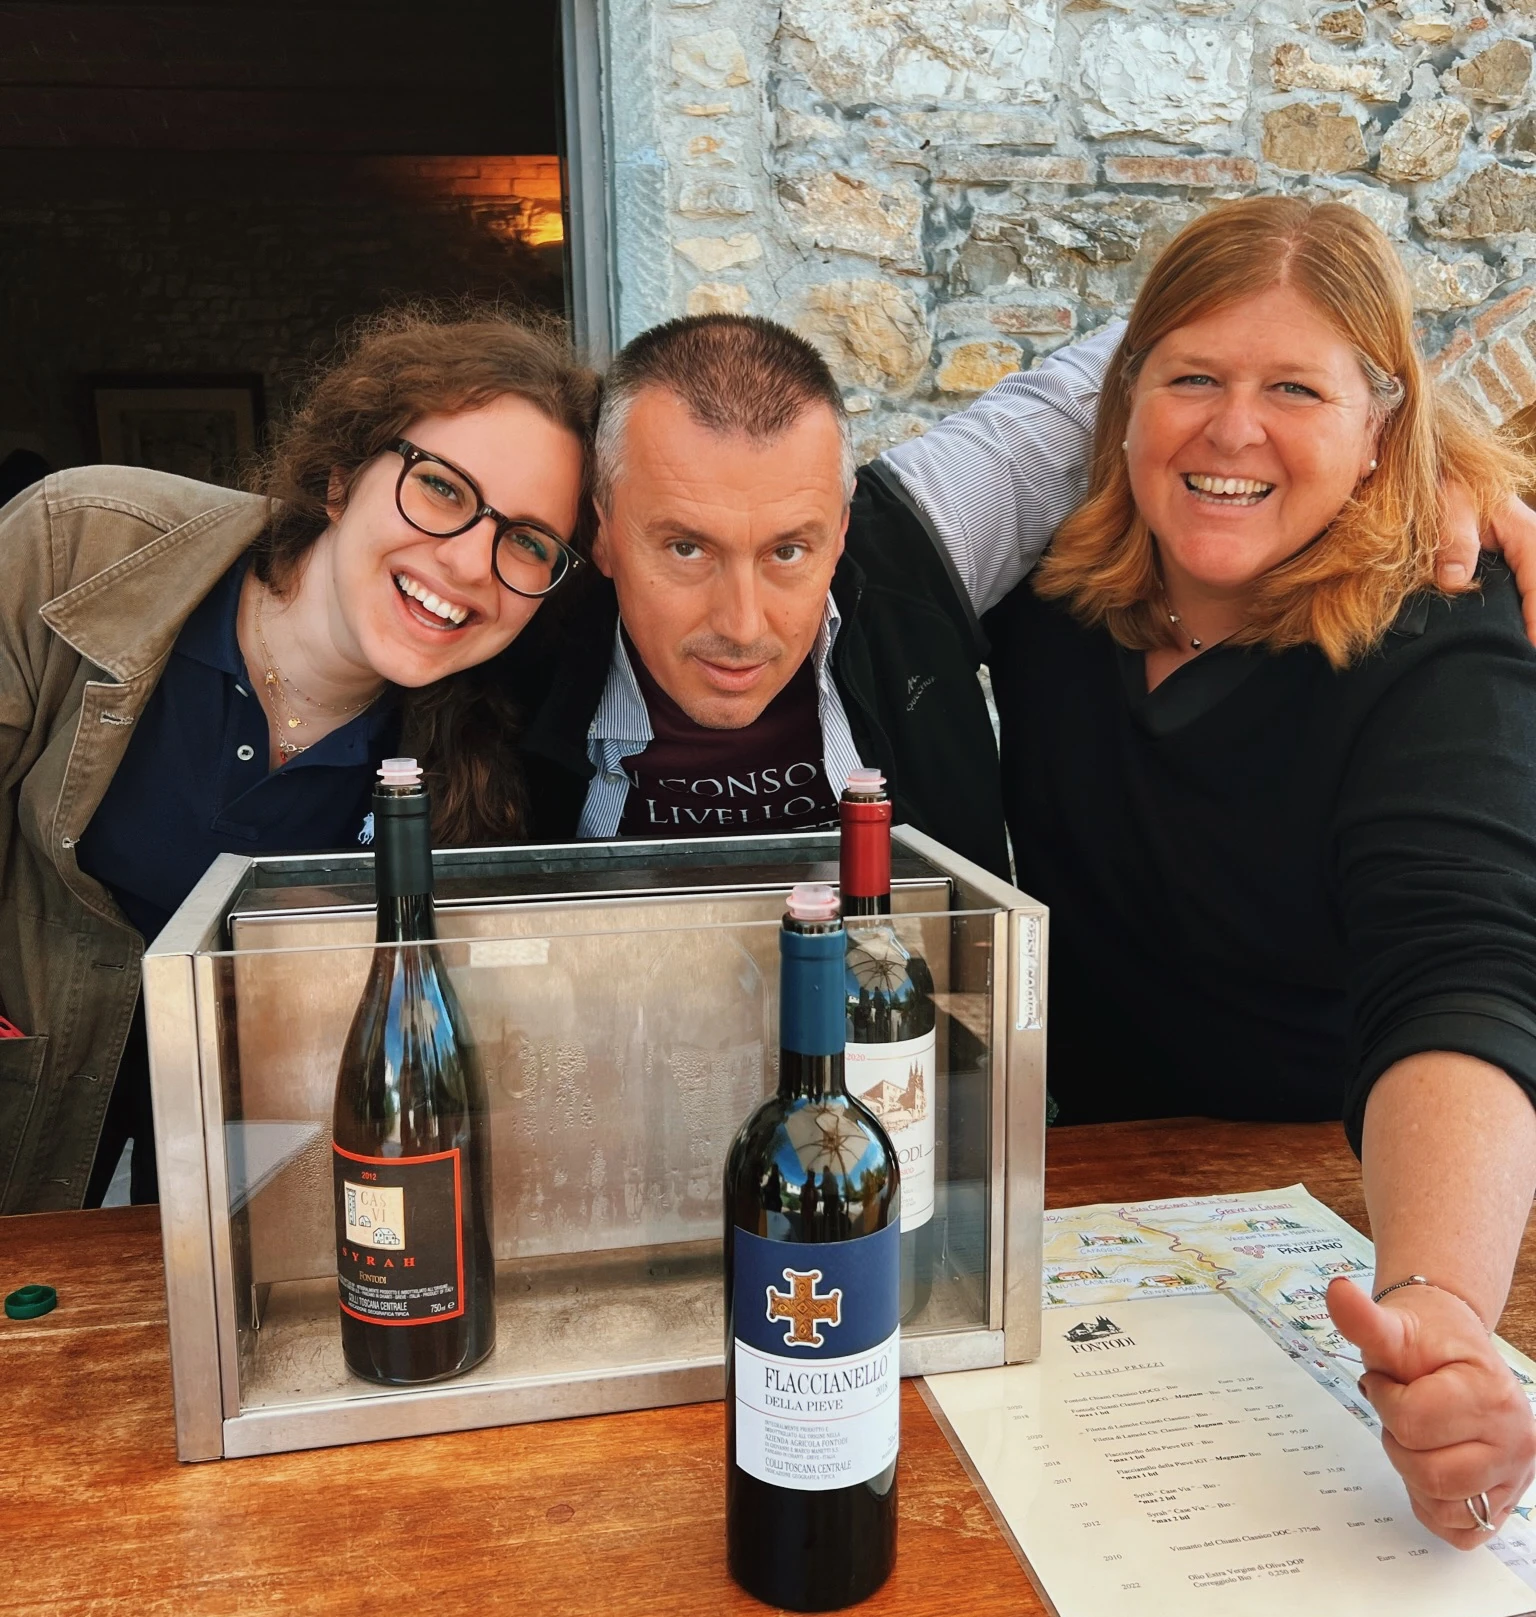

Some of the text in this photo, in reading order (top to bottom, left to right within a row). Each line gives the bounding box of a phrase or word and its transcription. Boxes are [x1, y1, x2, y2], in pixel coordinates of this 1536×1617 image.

[658, 758, 826, 798] CONSO
[845, 1053, 866, 1061] 2020
[361, 1171, 377, 1181] 2012
[1277, 1242, 1343, 1255] PANZANO
[342, 1247, 416, 1268] SYRAH
[359, 1297, 380, 1309] TOSCANA
[380, 1302, 408, 1311] CENTRALE
[1071, 1337, 1137, 1353] FONTODI
[764, 1354, 888, 1395] FLACCIANELLO
[1073, 1361, 1165, 1378] LISTINO PREZZI
[764, 1394, 843, 1411] DELLA PIEVE
[1064, 1395, 1088, 1404] Fontodi
[1088, 1393, 1110, 1401] Chianti
[1112, 1390, 1138, 1399] Classico
[1138, 1387, 1160, 1396] DOCG
[1071, 1405, 1095, 1413] Fontodi
[1096, 1403, 1118, 1411] Chianti
[1119, 1400, 1146, 1409] Classico
[1146, 1396, 1169, 1405] DOCG
[1175, 1392, 1203, 1400] Magnum
[1163, 1415, 1190, 1423] Classico
[1160, 1426, 1187, 1434] Classico
[1194, 1422, 1223, 1430] Magnum
[765, 1433, 848, 1448] AZIENDA AGRICOLA FONTODI
[1104, 1448, 1144, 1458] Flaccianello
[1162, 1443, 1181, 1451] Pieve
[765, 1457, 852, 1474] COLLI TOSCANA CENTRALE
[1116, 1465, 1156, 1475] Flaccianello
[1157, 1462, 1174, 1470] della
[1175, 1459, 1194, 1467] Pieve
[1133, 1491, 1153, 1499] Syrah
[1147, 1510, 1167, 1518] Syrah
[1082, 1520, 1101, 1528] 2012
[1346, 1520, 1365, 1528] Euro
[1169, 1543, 1202, 1552] Vinsanto
[1203, 1540, 1214, 1548] del
[1215, 1537, 1241, 1546] Chianti
[1242, 1533, 1272, 1542] Classico
[1272, 1529, 1292, 1537] DOC
[1103, 1554, 1122, 1562] 2010
[1376, 1548, 1429, 1562] Euro 12,00
[1188, 1573, 1205, 1581] Olio
[1205, 1569, 1226, 1579] Extra
[1226, 1564, 1256, 1575] Vergine
[1265, 1561, 1286, 1570] Oliva
[1286, 1558, 1305, 1567] DOP
[1121, 1582, 1141, 1590] 2022
[1193, 1577, 1237, 1588] Correggiolo
